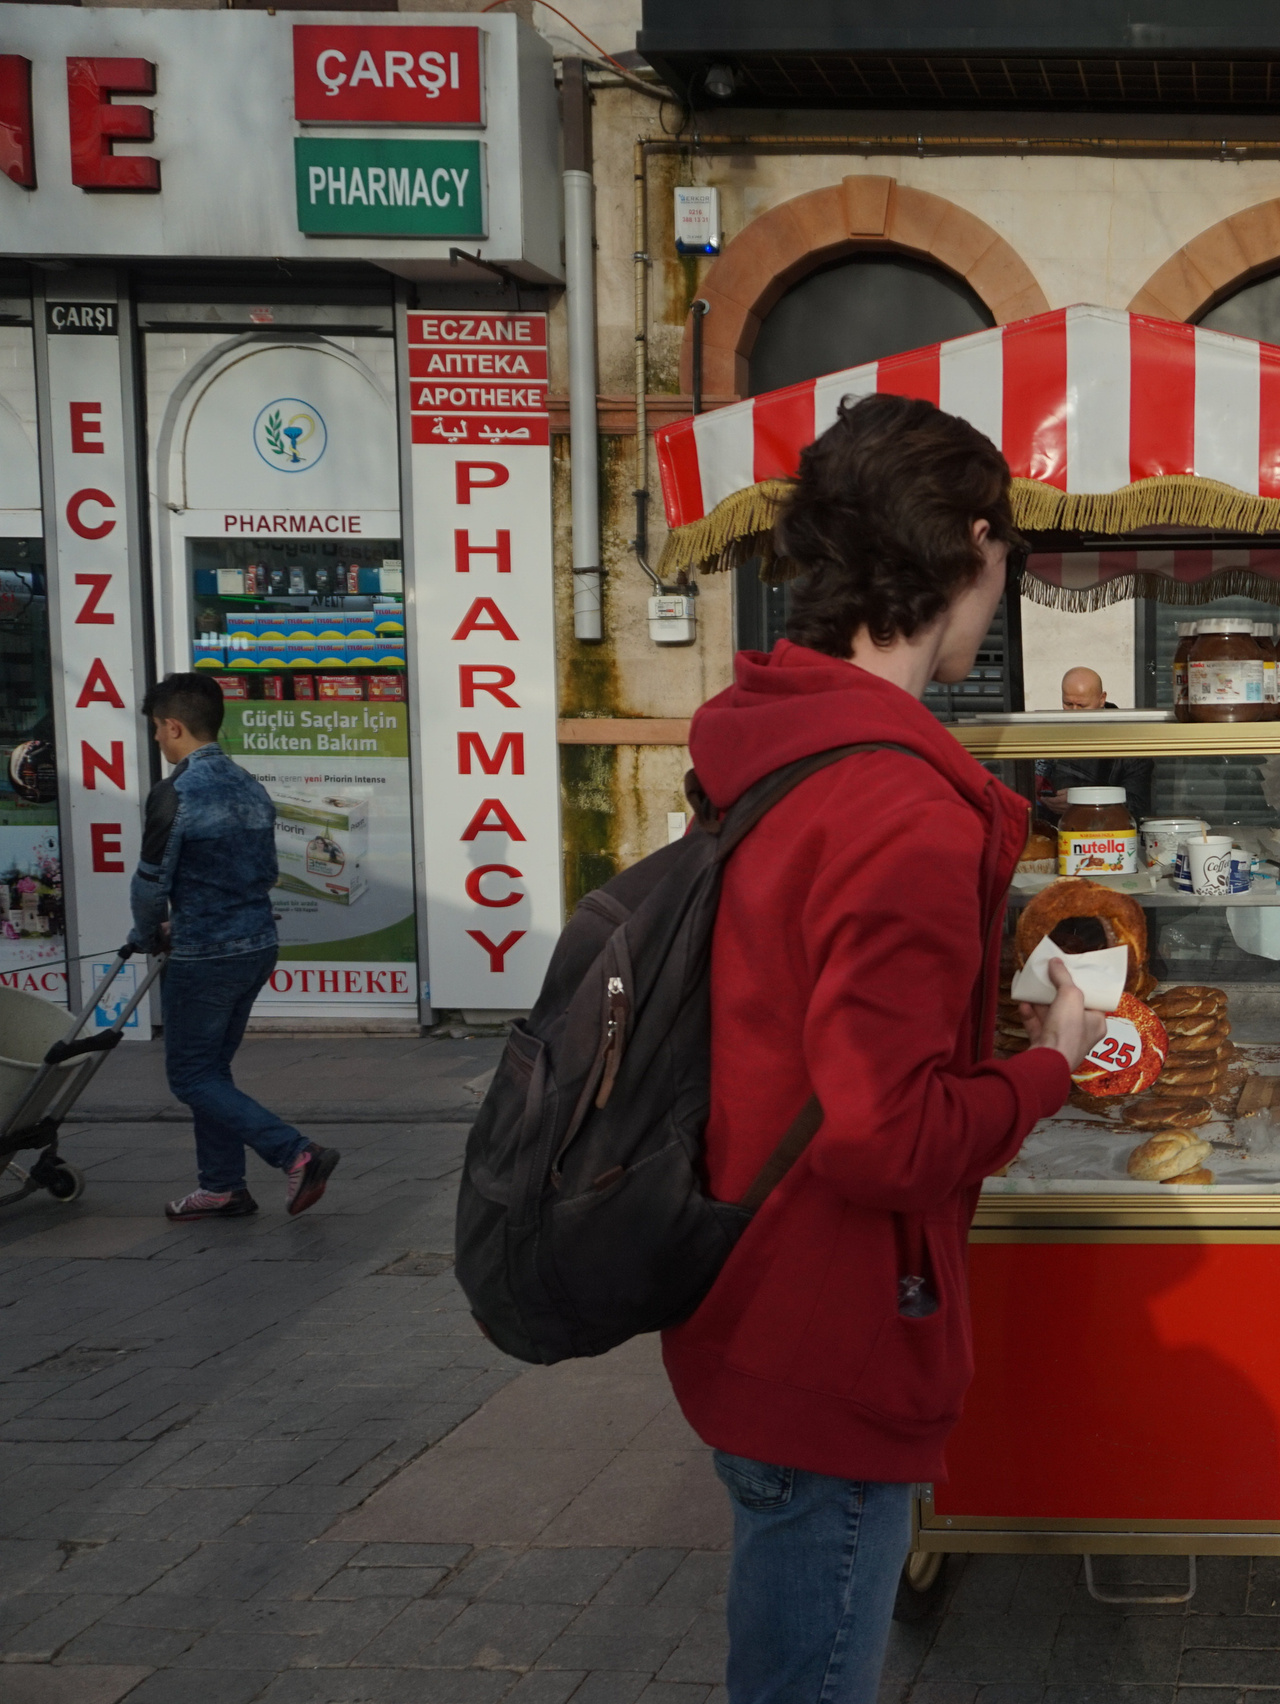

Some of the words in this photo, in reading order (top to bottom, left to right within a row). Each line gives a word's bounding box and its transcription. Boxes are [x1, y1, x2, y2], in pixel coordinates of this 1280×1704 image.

[316, 49, 460, 98] ÇARŞI
[309, 166, 469, 207] PHARMACY
[51, 306, 113, 331] ÇARŞI
[422, 319, 531, 341] ECZANE
[427, 353, 530, 374] АПТЕКА
[418, 387, 542, 407] APOTHEKE
[478, 424, 530, 443] صيد
[224, 514, 362, 533] PHARMACIE
[65, 401, 126, 873] ECZANE
[242, 709, 295, 732] Güçlü
[300, 710, 359, 732] Saçlar
[363, 707, 398, 733] İçin
[450, 460, 528, 973] PHARMACY
[243, 733, 312, 751] Kökten
[317, 733, 377, 751] Bakım
[304, 774, 322, 786] yeni
[324, 775, 353, 784] Priorin
[354, 775, 386, 784] Intense
[1073, 839, 1125, 855] nutella
[1087, 1037, 1136, 1068] .25
